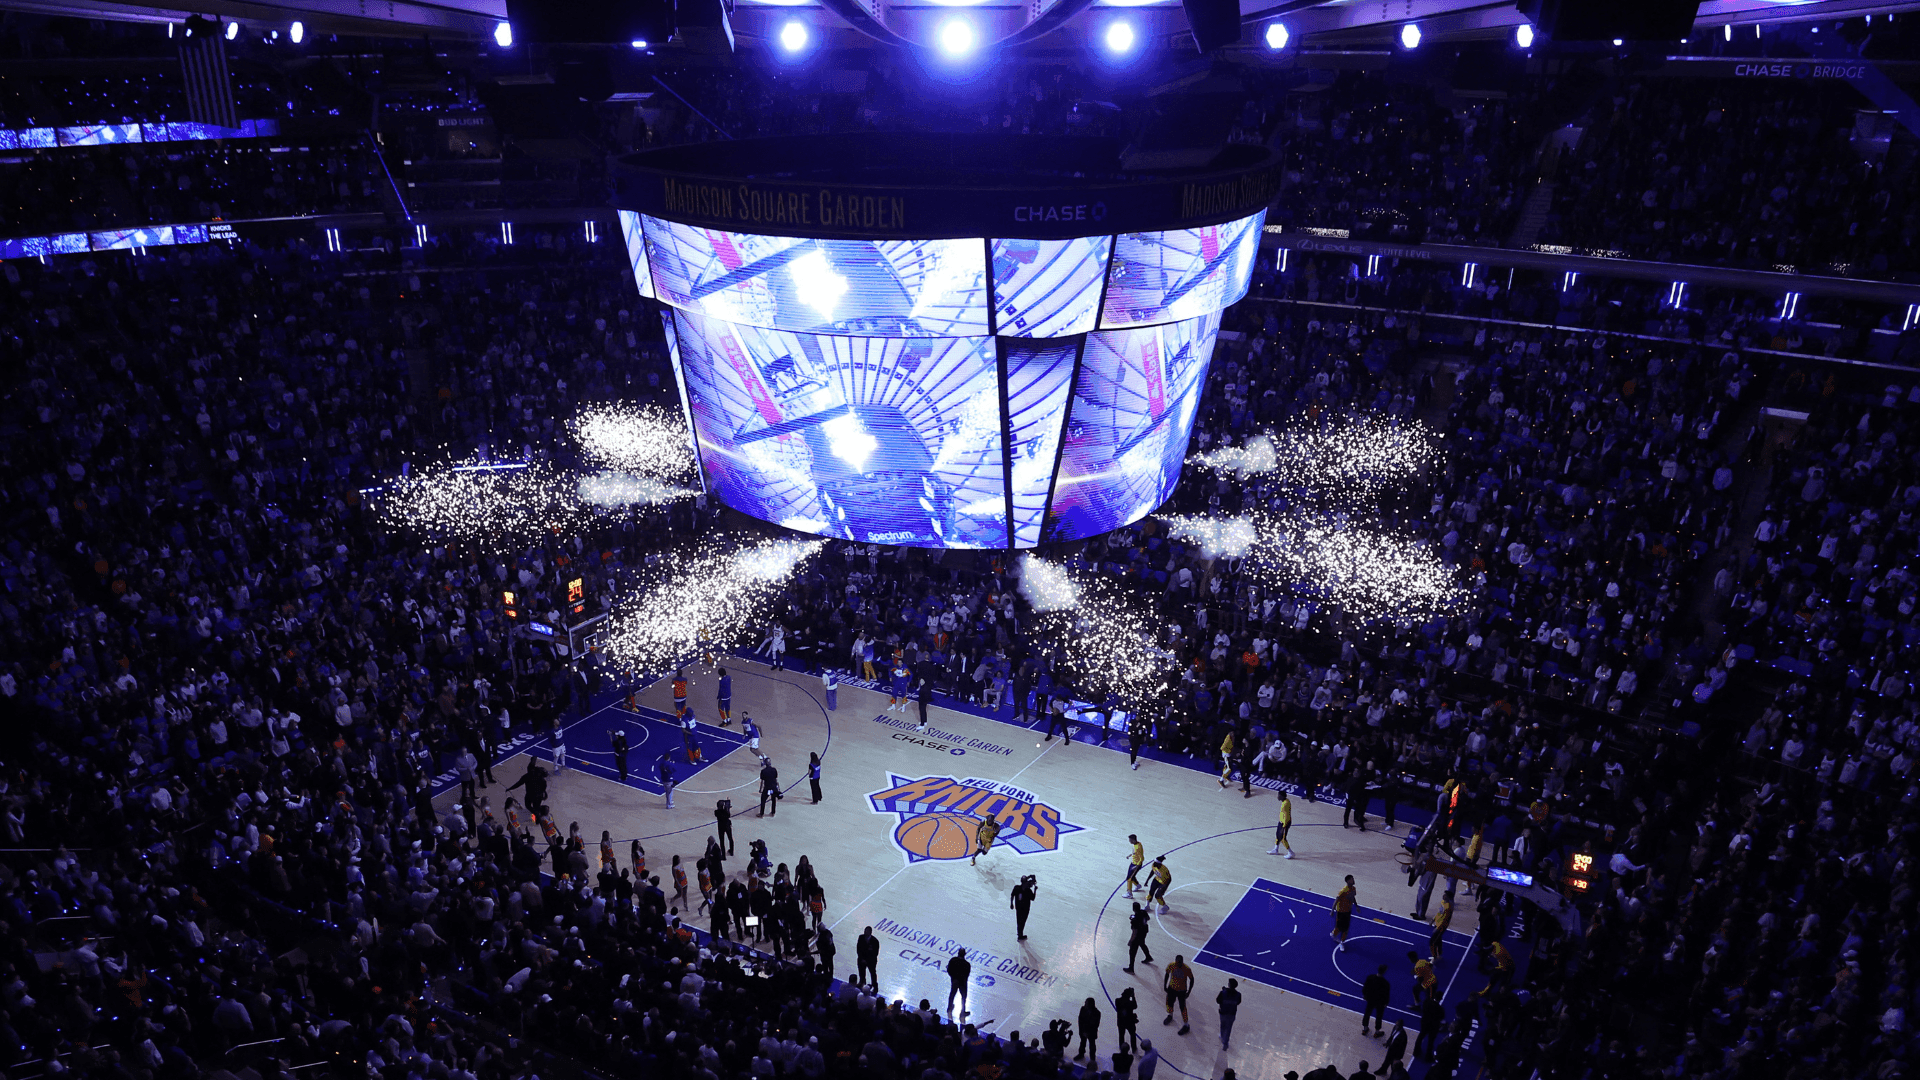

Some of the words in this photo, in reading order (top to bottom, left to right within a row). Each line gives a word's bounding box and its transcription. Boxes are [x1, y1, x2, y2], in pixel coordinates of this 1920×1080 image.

[1735, 64, 1792, 76] CHASE
[1813, 65, 1866, 78] BRIDGE
[438, 118, 457, 126] BUD
[664, 177, 733, 218] MADISON
[738, 185, 811, 225] SQUARE
[819, 189, 905, 229] GARDEN
[1181, 182, 1238, 219] MADISON
[1014, 205, 1087, 222] CHASE
[1315, 244, 1363, 254] LEXUS
[867, 531, 914, 543] Spectrum
[568, 586, 584, 603] 24
[892, 733, 949, 752] CHASE
[923, 727, 968, 744] SQUARE
[967, 738, 1014, 756] GARDEN
[960, 779, 998, 789] NEW
[999, 785, 1035, 803] YORK
[870, 777, 1061, 850] KNICKS
[1573, 861, 1588, 871] 24
[874, 917, 941, 948] MADISON
[997, 958, 1058, 987] GARDEN
[899, 949, 949, 973] CHA
